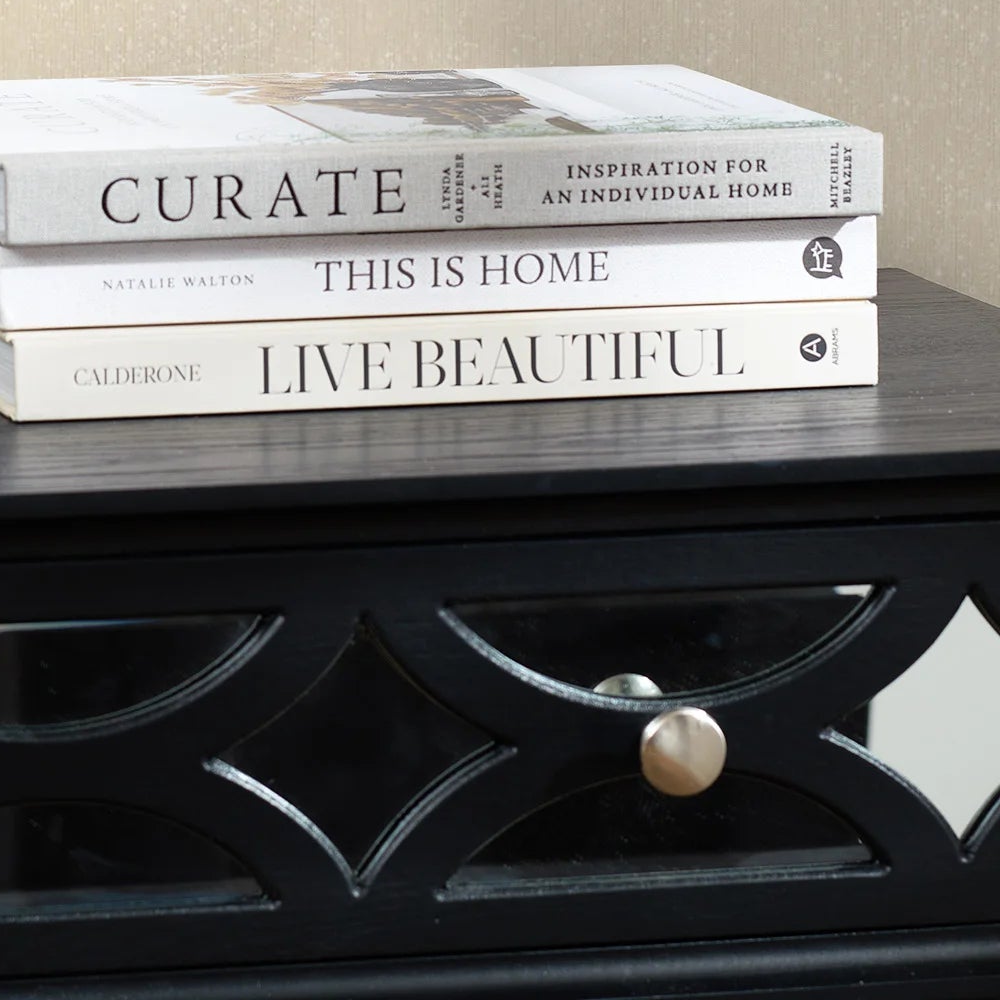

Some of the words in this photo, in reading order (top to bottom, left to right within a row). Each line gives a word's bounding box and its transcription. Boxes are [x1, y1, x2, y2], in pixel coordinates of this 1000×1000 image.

[441, 166, 452, 211] LYNDA
[454, 153, 465, 224] GARDENER
[480, 175, 490, 199] ALI
[493, 163, 504, 210] HEATH
[566, 159, 717, 180] INSPIRATION
[725, 158, 768, 174] FOR
[829, 142, 840, 209] MITCHELL
[842, 146, 853, 204] BEAZLEY
[101, 167, 406, 224] CURATE
[541, 189, 573, 205] AN
[580, 184, 720, 204] INDIVIDUAL
[728, 181, 793, 199] HOME
[102, 276, 176, 290] NATALIE
[182, 273, 254, 287] WALTON
[313, 258, 416, 292] THIS
[430, 255, 465, 288] IS
[478, 250, 610, 286] HOME
[257, 341, 393, 395] LIVE
[412, 328, 745, 389] BEAUTIFUL
[831, 327, 840, 366] ABRAMS
[72, 362, 203, 387] CALDERONE
